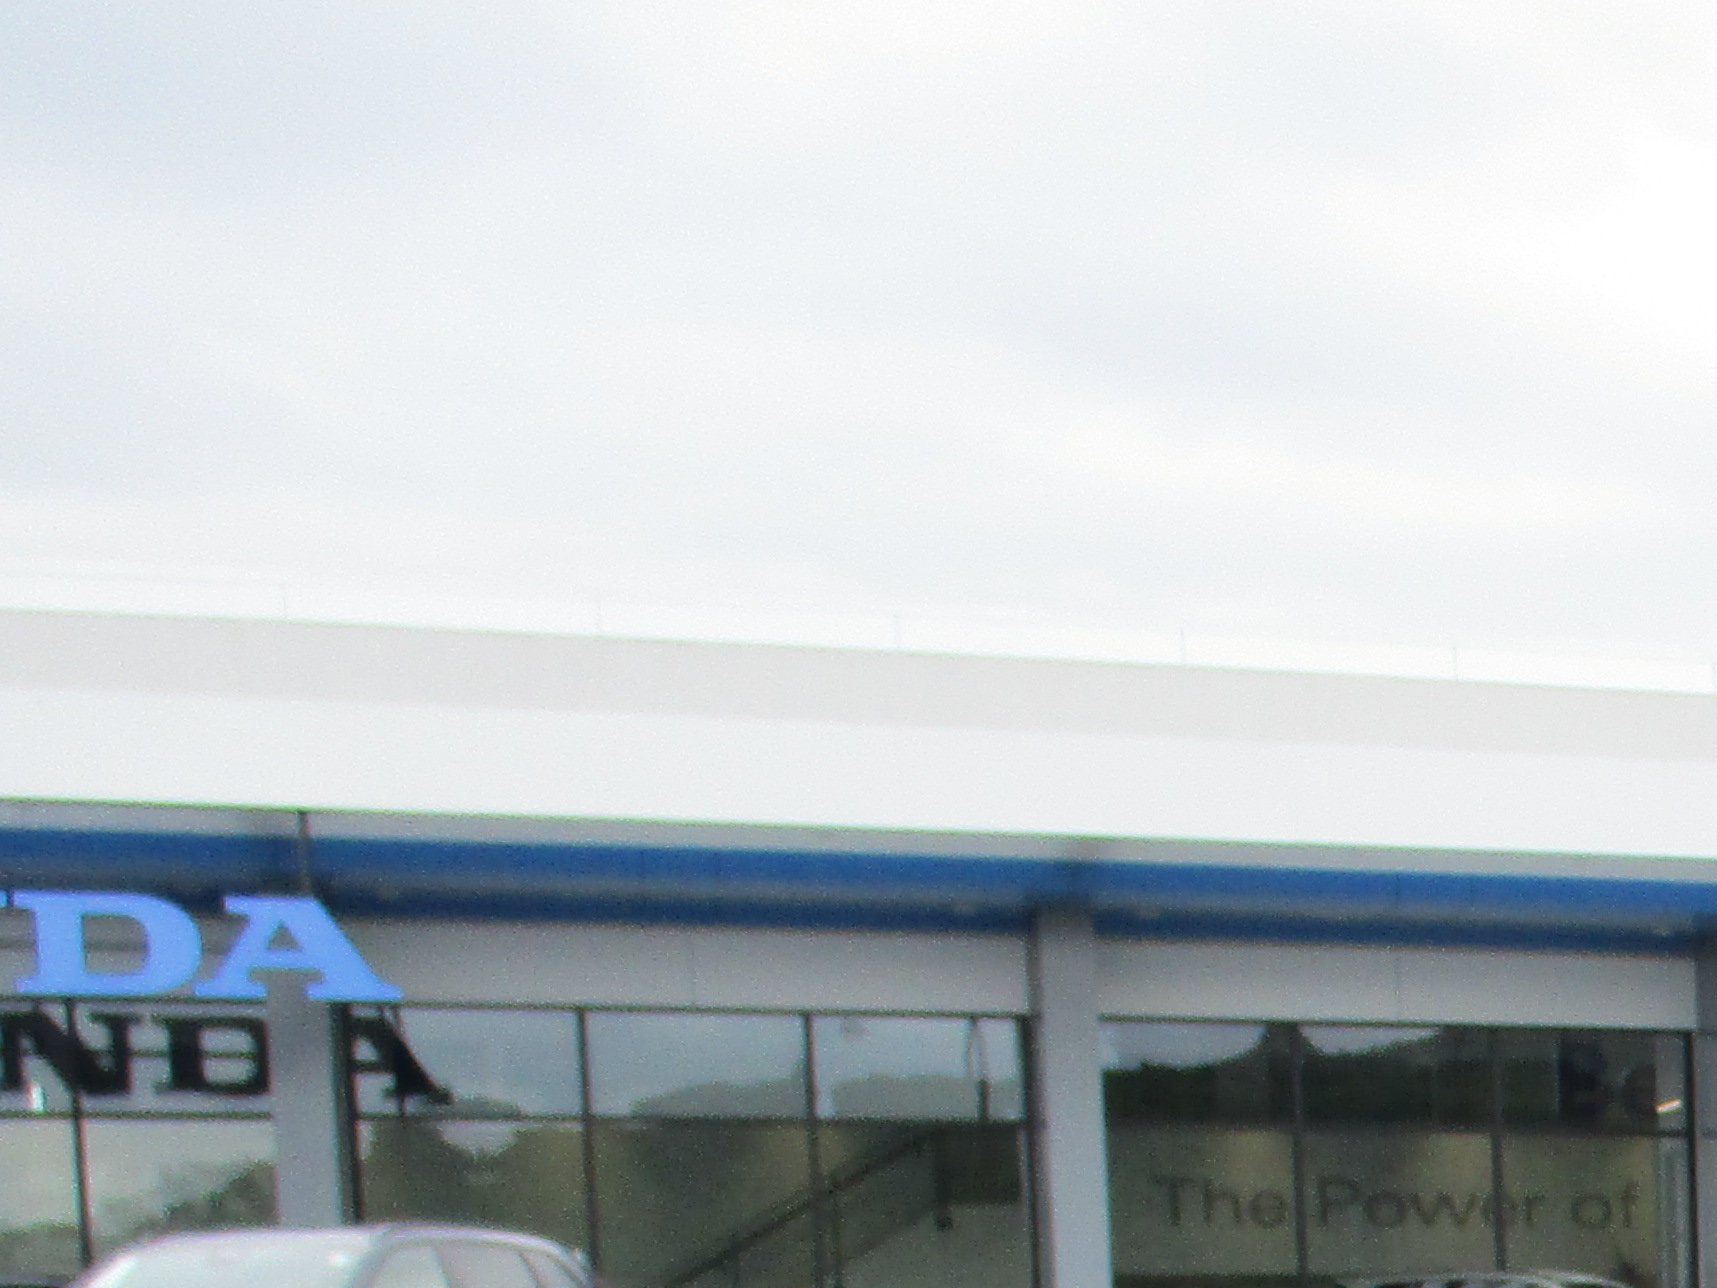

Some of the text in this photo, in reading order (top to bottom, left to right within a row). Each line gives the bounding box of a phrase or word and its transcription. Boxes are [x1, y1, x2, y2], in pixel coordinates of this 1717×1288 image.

[0, 889, 404, 1001] DA
[1150, 1173, 1639, 1230] The Power of
